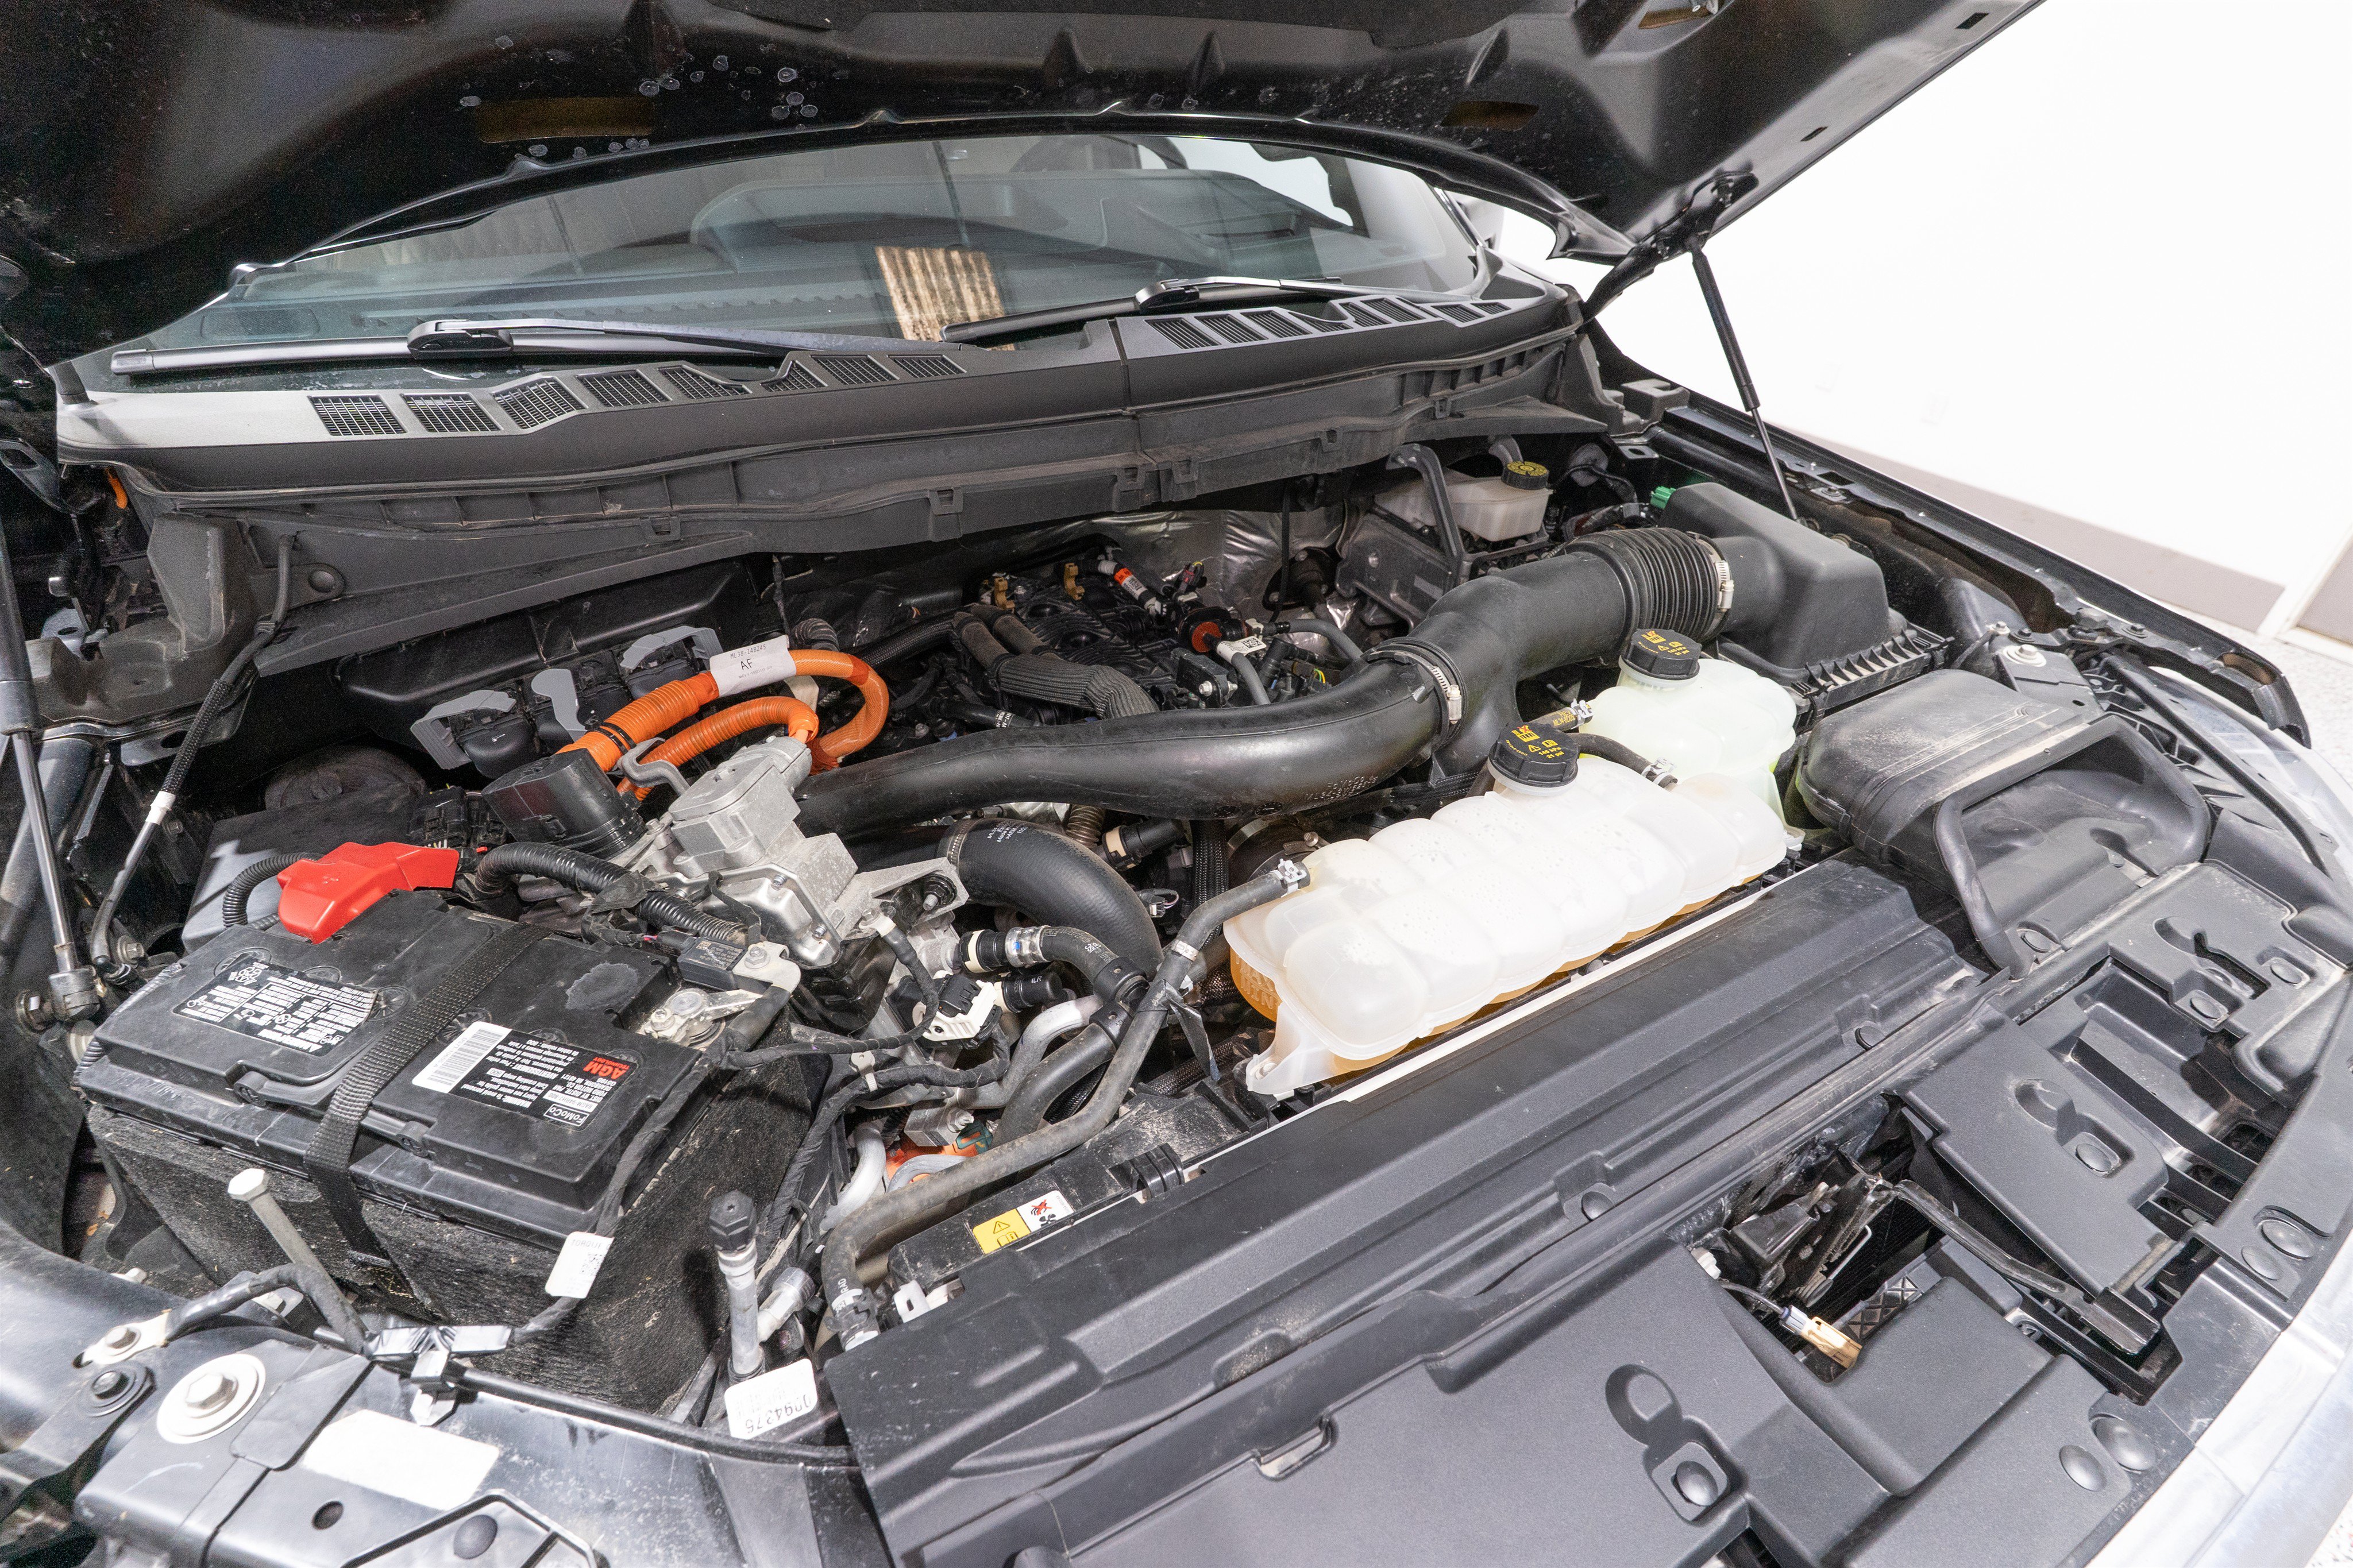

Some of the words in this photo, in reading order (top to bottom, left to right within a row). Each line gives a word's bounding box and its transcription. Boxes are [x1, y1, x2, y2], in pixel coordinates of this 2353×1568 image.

[730, 644, 766, 659] ML38-14B245
[740, 658, 753, 670] AF
[996, 830, 1008, 843] Made
[1240, 975, 1274, 1010] MIN
[593, 1057, 629, 1069] TECHNOLOGY
[512, 1064, 558, 1079] AVERTISSEMENT
[515, 1076, 537, 1085] cranking
[461, 1084, 485, 1092] personal
[574, 1084, 593, 1092] MOTOR
[592, 1088, 607, 1096] FORD
[549, 1107, 585, 1123] FoMoCo
